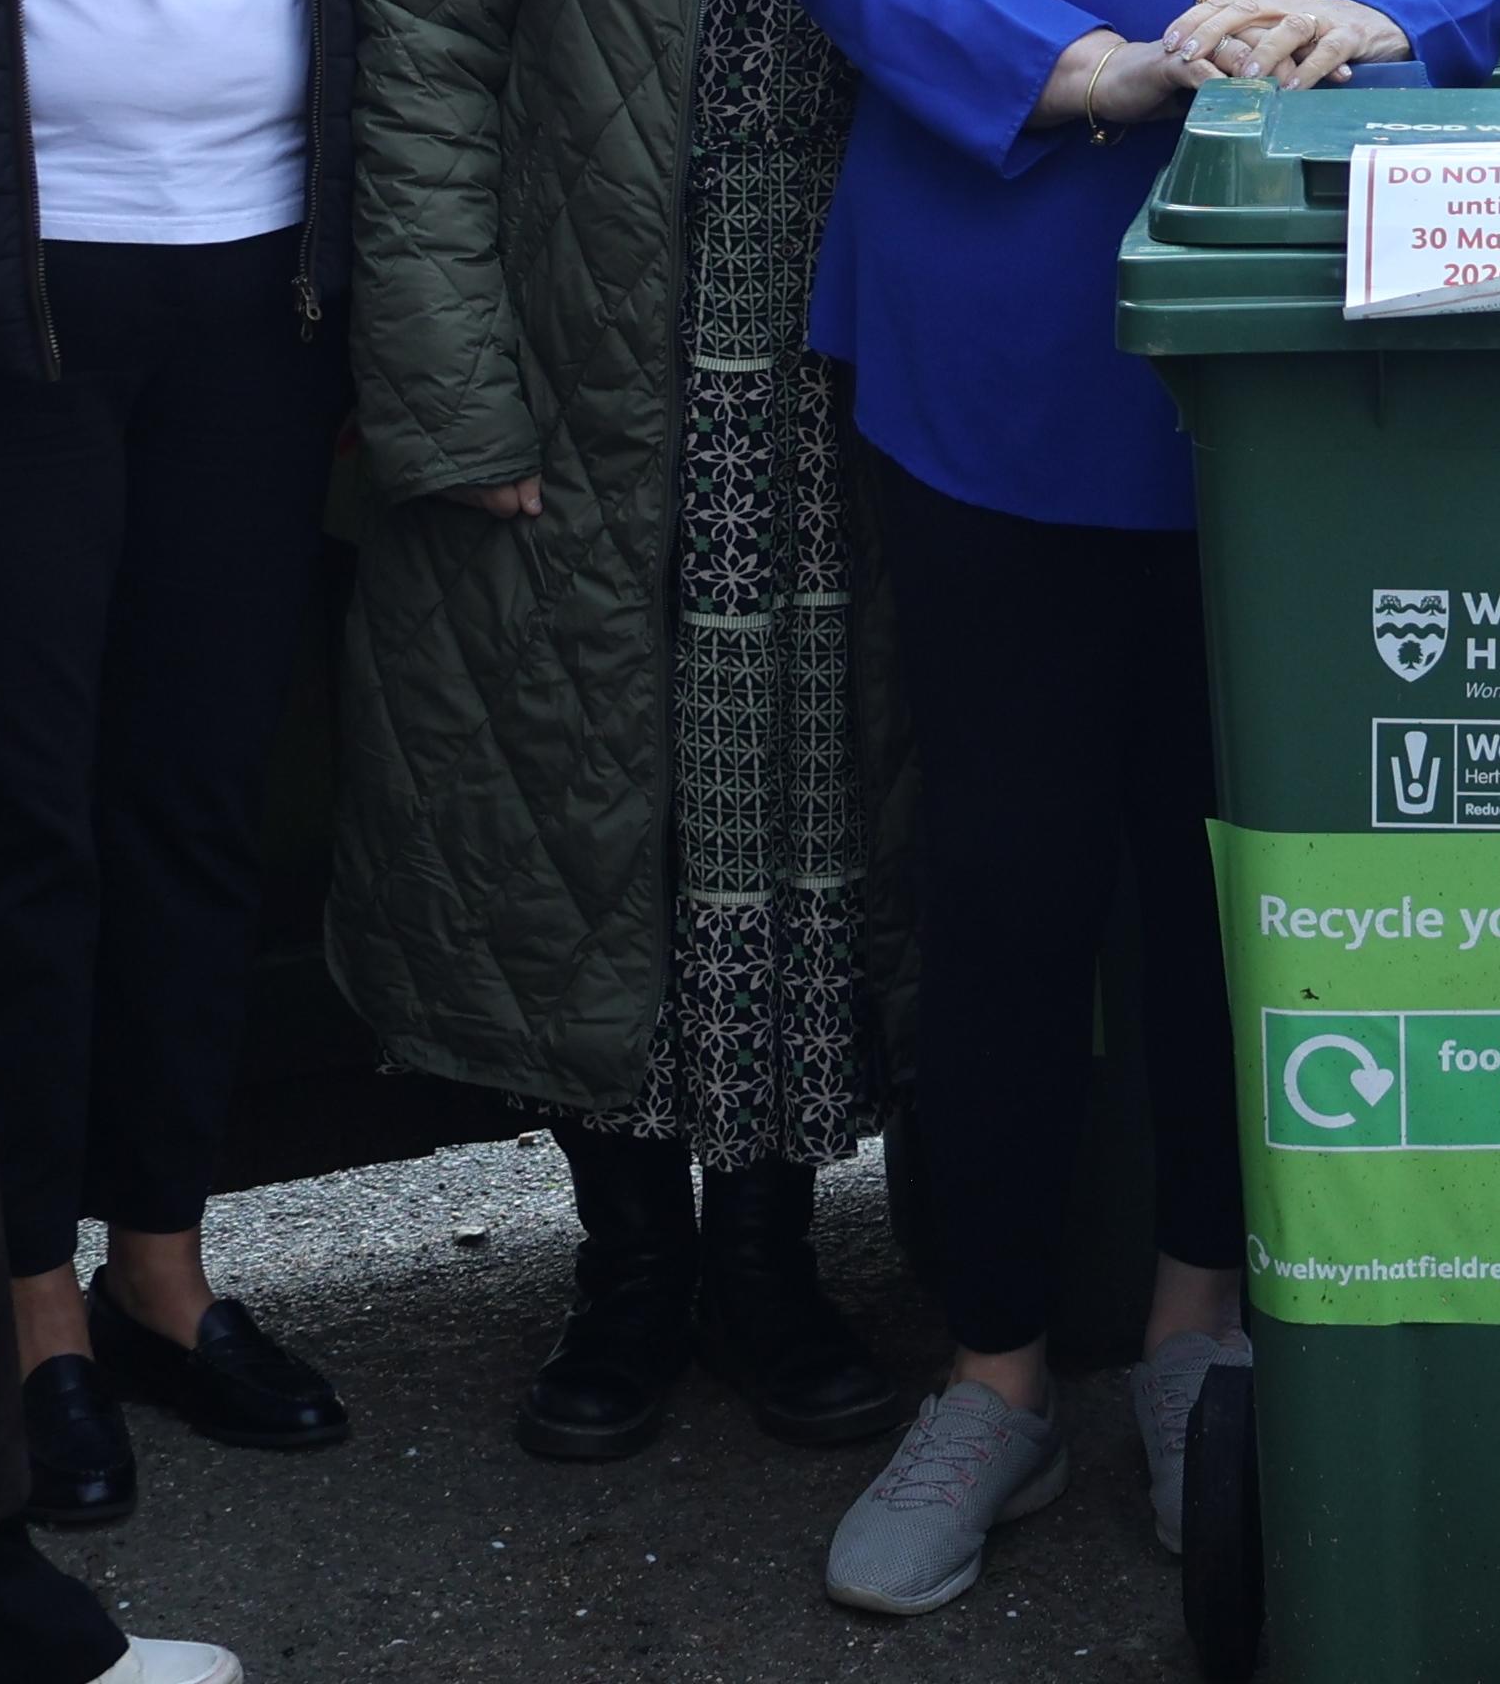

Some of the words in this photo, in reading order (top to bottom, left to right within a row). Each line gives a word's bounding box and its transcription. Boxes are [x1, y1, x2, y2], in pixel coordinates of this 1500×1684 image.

[1365, 121, 1468, 132] FOOD
[1388, 166, 1432, 184] DO
[1411, 227, 1447, 250] 30
[1260, 894, 1443, 951] Recycle
